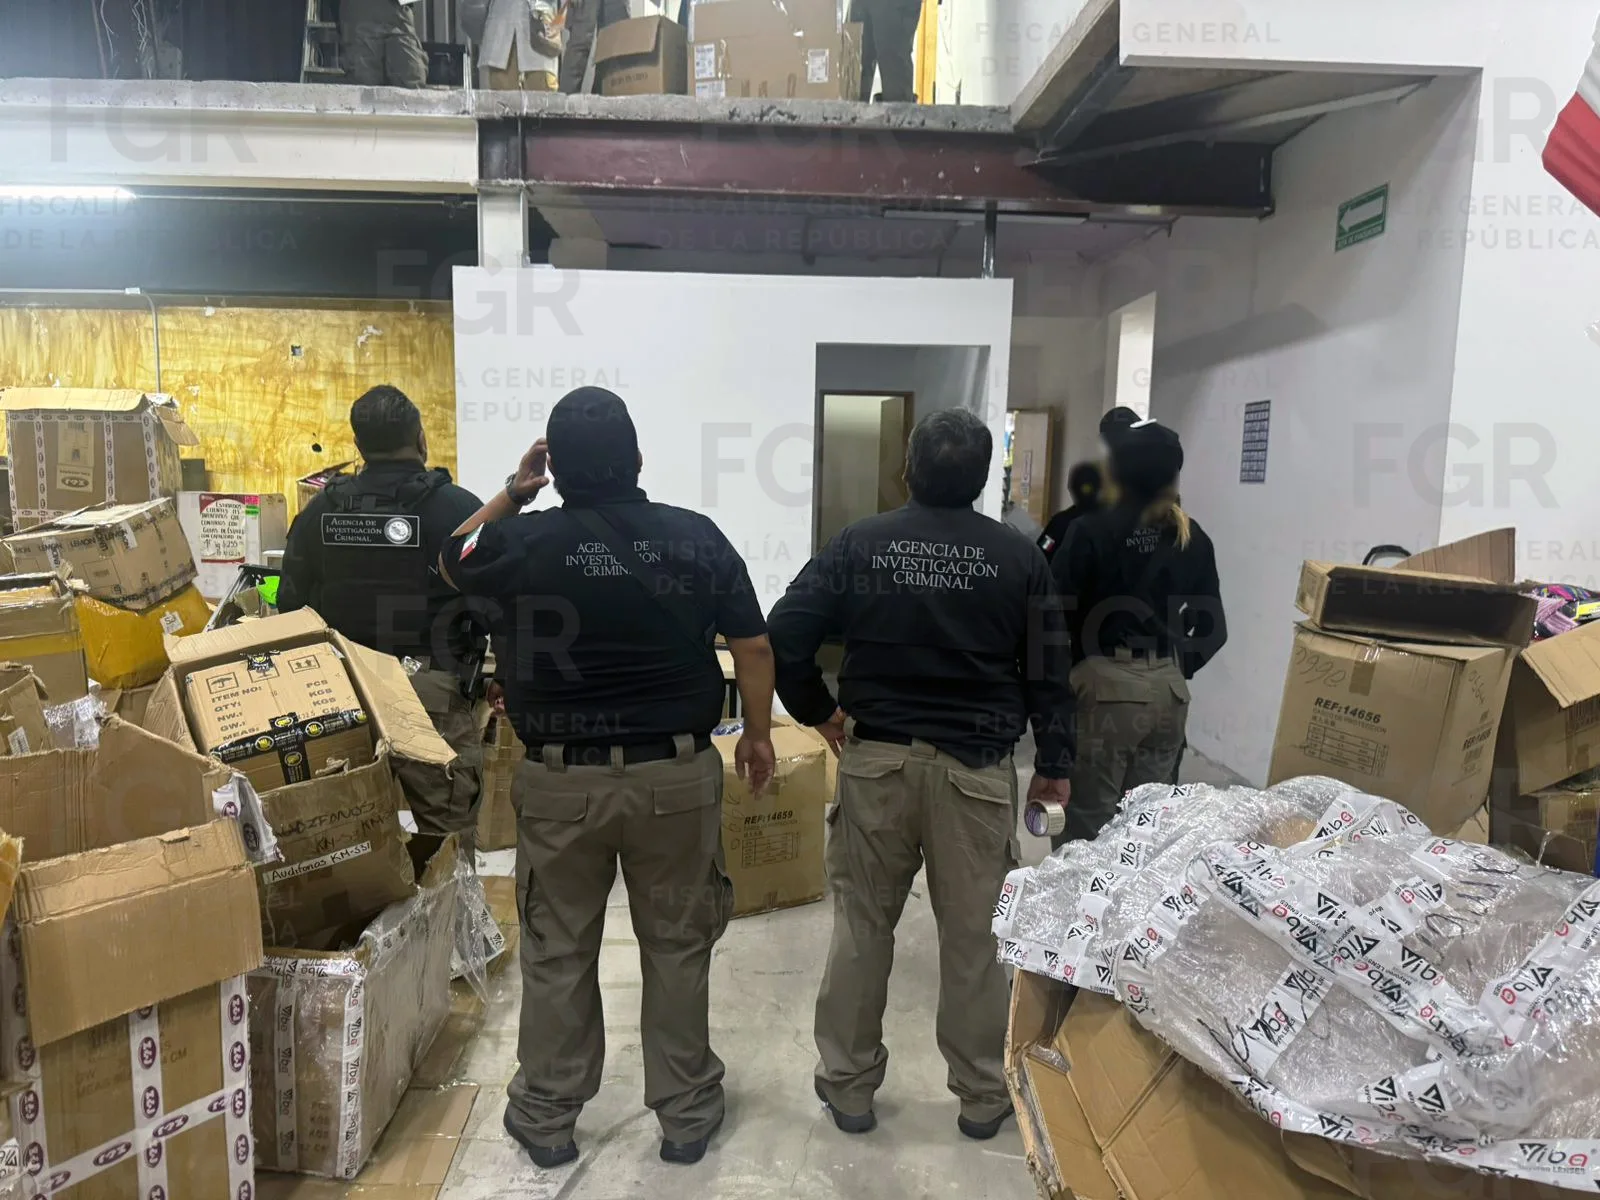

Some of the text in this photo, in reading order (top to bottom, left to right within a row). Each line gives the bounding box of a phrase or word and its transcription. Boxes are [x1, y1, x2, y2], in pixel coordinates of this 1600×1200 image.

[331, 517, 364, 527] AGENCIA
[334, 533, 372, 542] CRIMINAL
[633, 541, 650, 552] DE
[887, 540, 985, 560] AGENCIA DE
[872, 555, 999, 579] INVESTIGACIÓN
[893, 571, 974, 590] CRIMINAL
[211, 692, 240, 704] ITEM
[1314, 697, 1382, 725] REF:14656
[1518, 1142, 1588, 1167] Viba
